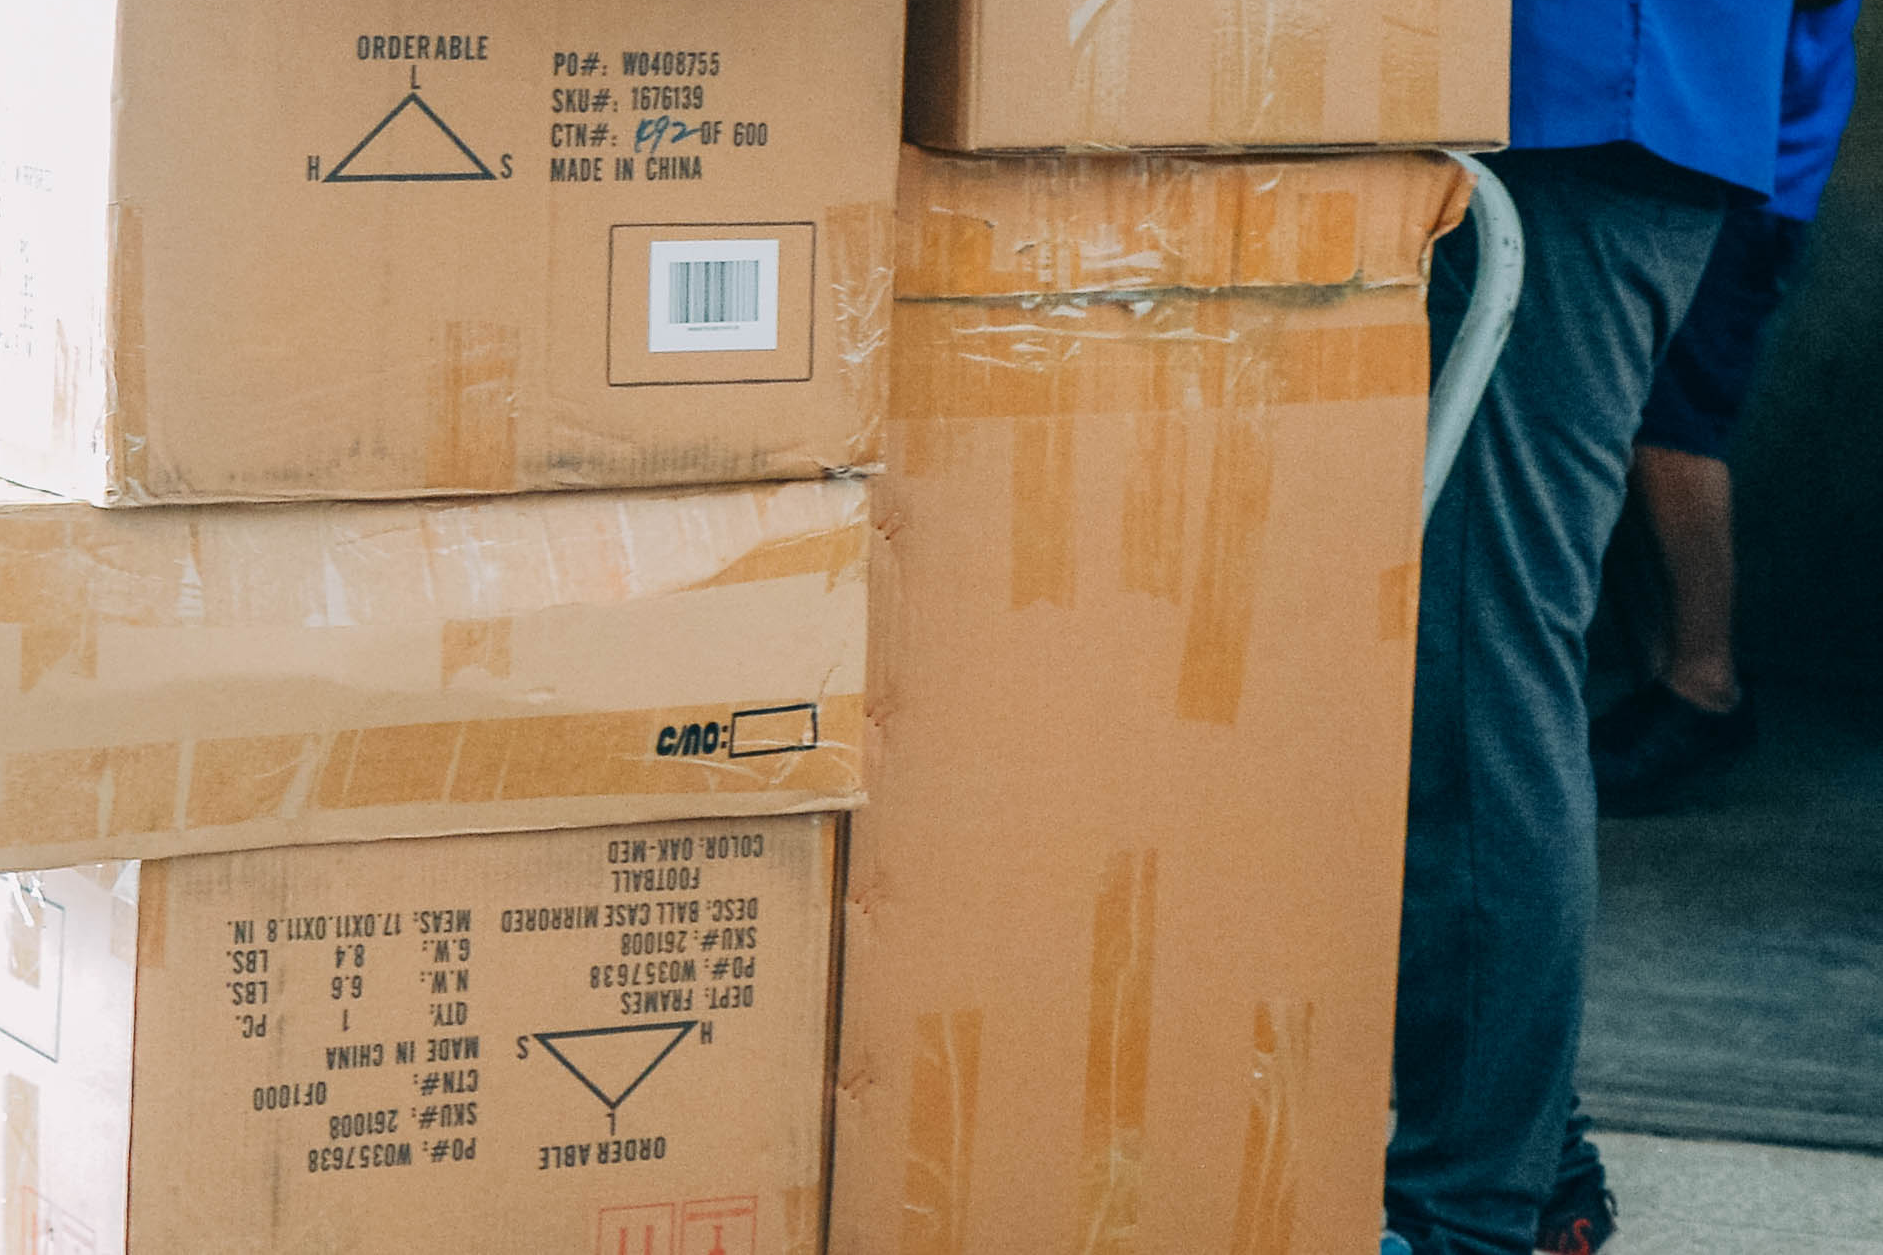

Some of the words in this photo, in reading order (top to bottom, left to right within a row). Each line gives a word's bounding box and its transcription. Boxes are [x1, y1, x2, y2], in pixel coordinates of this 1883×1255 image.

[553, 52, 608, 77] PO#:
[410, 65, 421, 90] L
[552, 86, 619, 113] SKU#:
[631, 85, 704, 111] 1676139
[551, 123, 618, 148] CTN#:
[700, 122, 722, 146] OF
[734, 122, 768, 146] 600
[307, 155, 320, 180] H
[501, 153, 513, 179] S
[550, 156, 603, 182] MADE
[616, 156, 633, 182] IN
[645, 156, 703, 181] CHINA
[608, 838, 694, 865] OAK-MED
[702, 835, 764, 860] COLOR:
[614, 868, 700, 894] FOOTBALL
[414, 908, 472, 933] MEAS:
[501, 907, 598, 934] MIRRORED
[603, 904, 651, 928] CASE
[656, 900, 698, 925] BALL
[707, 897, 758, 922] DESC:
[621, 931, 687, 956] 261008
[692, 927, 757, 952] SKU#:
[226, 949, 269, 974] LBS.
[335, 944, 365, 968] 8.4
[705, 956, 755, 980] PO#:
[590, 959, 696, 989] W0357638
[226, 980, 269, 1005] LBS.
[331, 975, 363, 1000] 6.6
[706, 985, 753, 1010] DEPT:
[430, 1002, 467, 1026] QTY:
[620, 990, 692, 1015] FRAMES
[235, 1014, 266, 1038] PC.
[342, 1009, 350, 1032] 1
[700, 1021, 713, 1045] H
[325, 1042, 385, 1070] CHINA
[396, 1039, 415, 1064] IN
[426, 1036, 480, 1061] MADE
[516, 1036, 529, 1060] S
[413, 1069, 479, 1095] CTN#:
[329, 1108, 398, 1140] 261008
[412, 1103, 478, 1128] SKU#:
[606, 1111, 616, 1136] L
[308, 1143, 412, 1174] W0357638
[423, 1138, 476, 1162] PO#:
